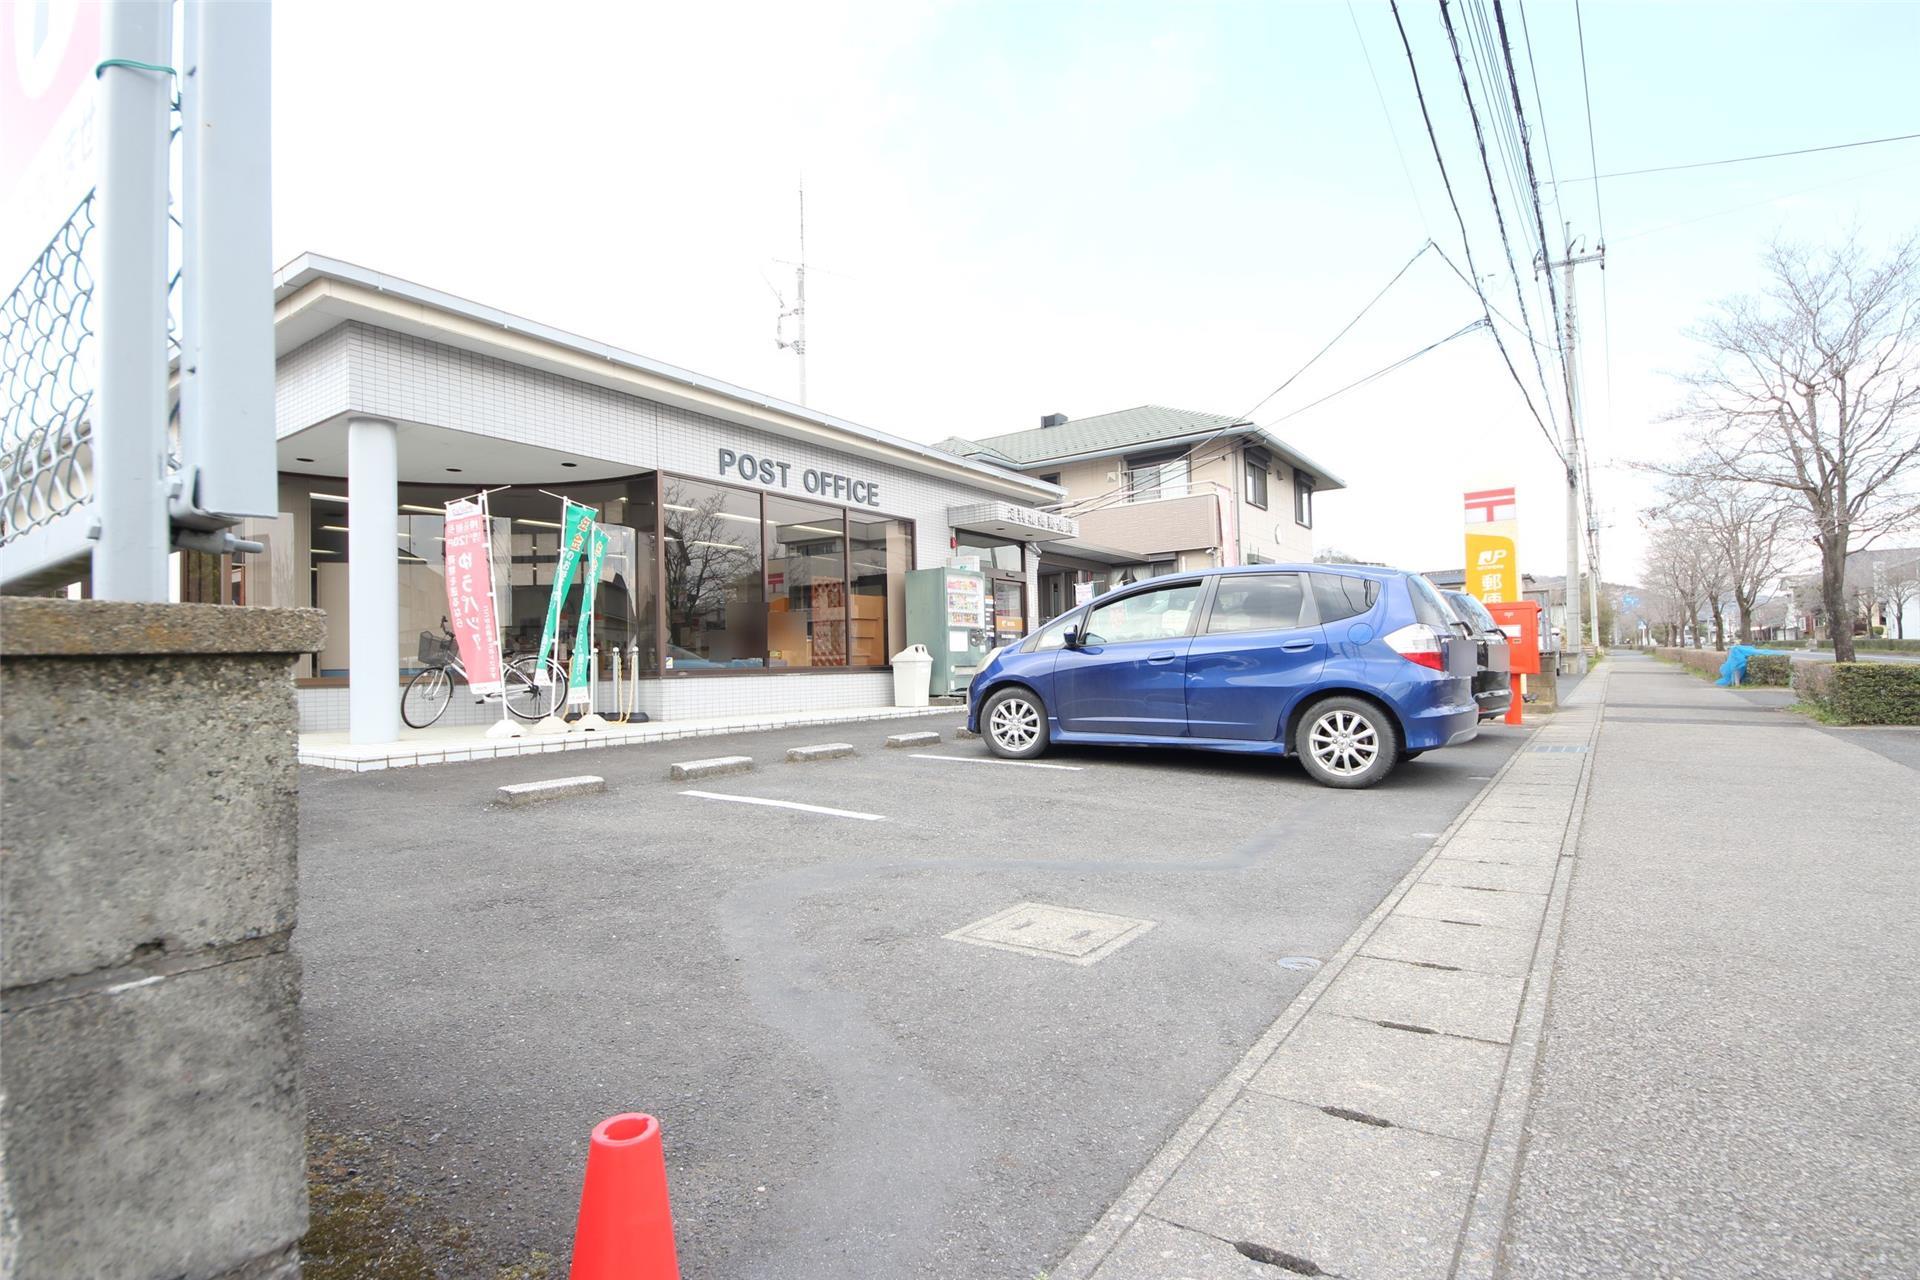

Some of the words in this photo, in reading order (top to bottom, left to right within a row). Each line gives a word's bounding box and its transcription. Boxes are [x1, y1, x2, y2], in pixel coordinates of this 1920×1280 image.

[719, 448, 791, 488] POST
[803, 469, 880, 507] OFFICE
[1477, 549, 1507, 566] JP
